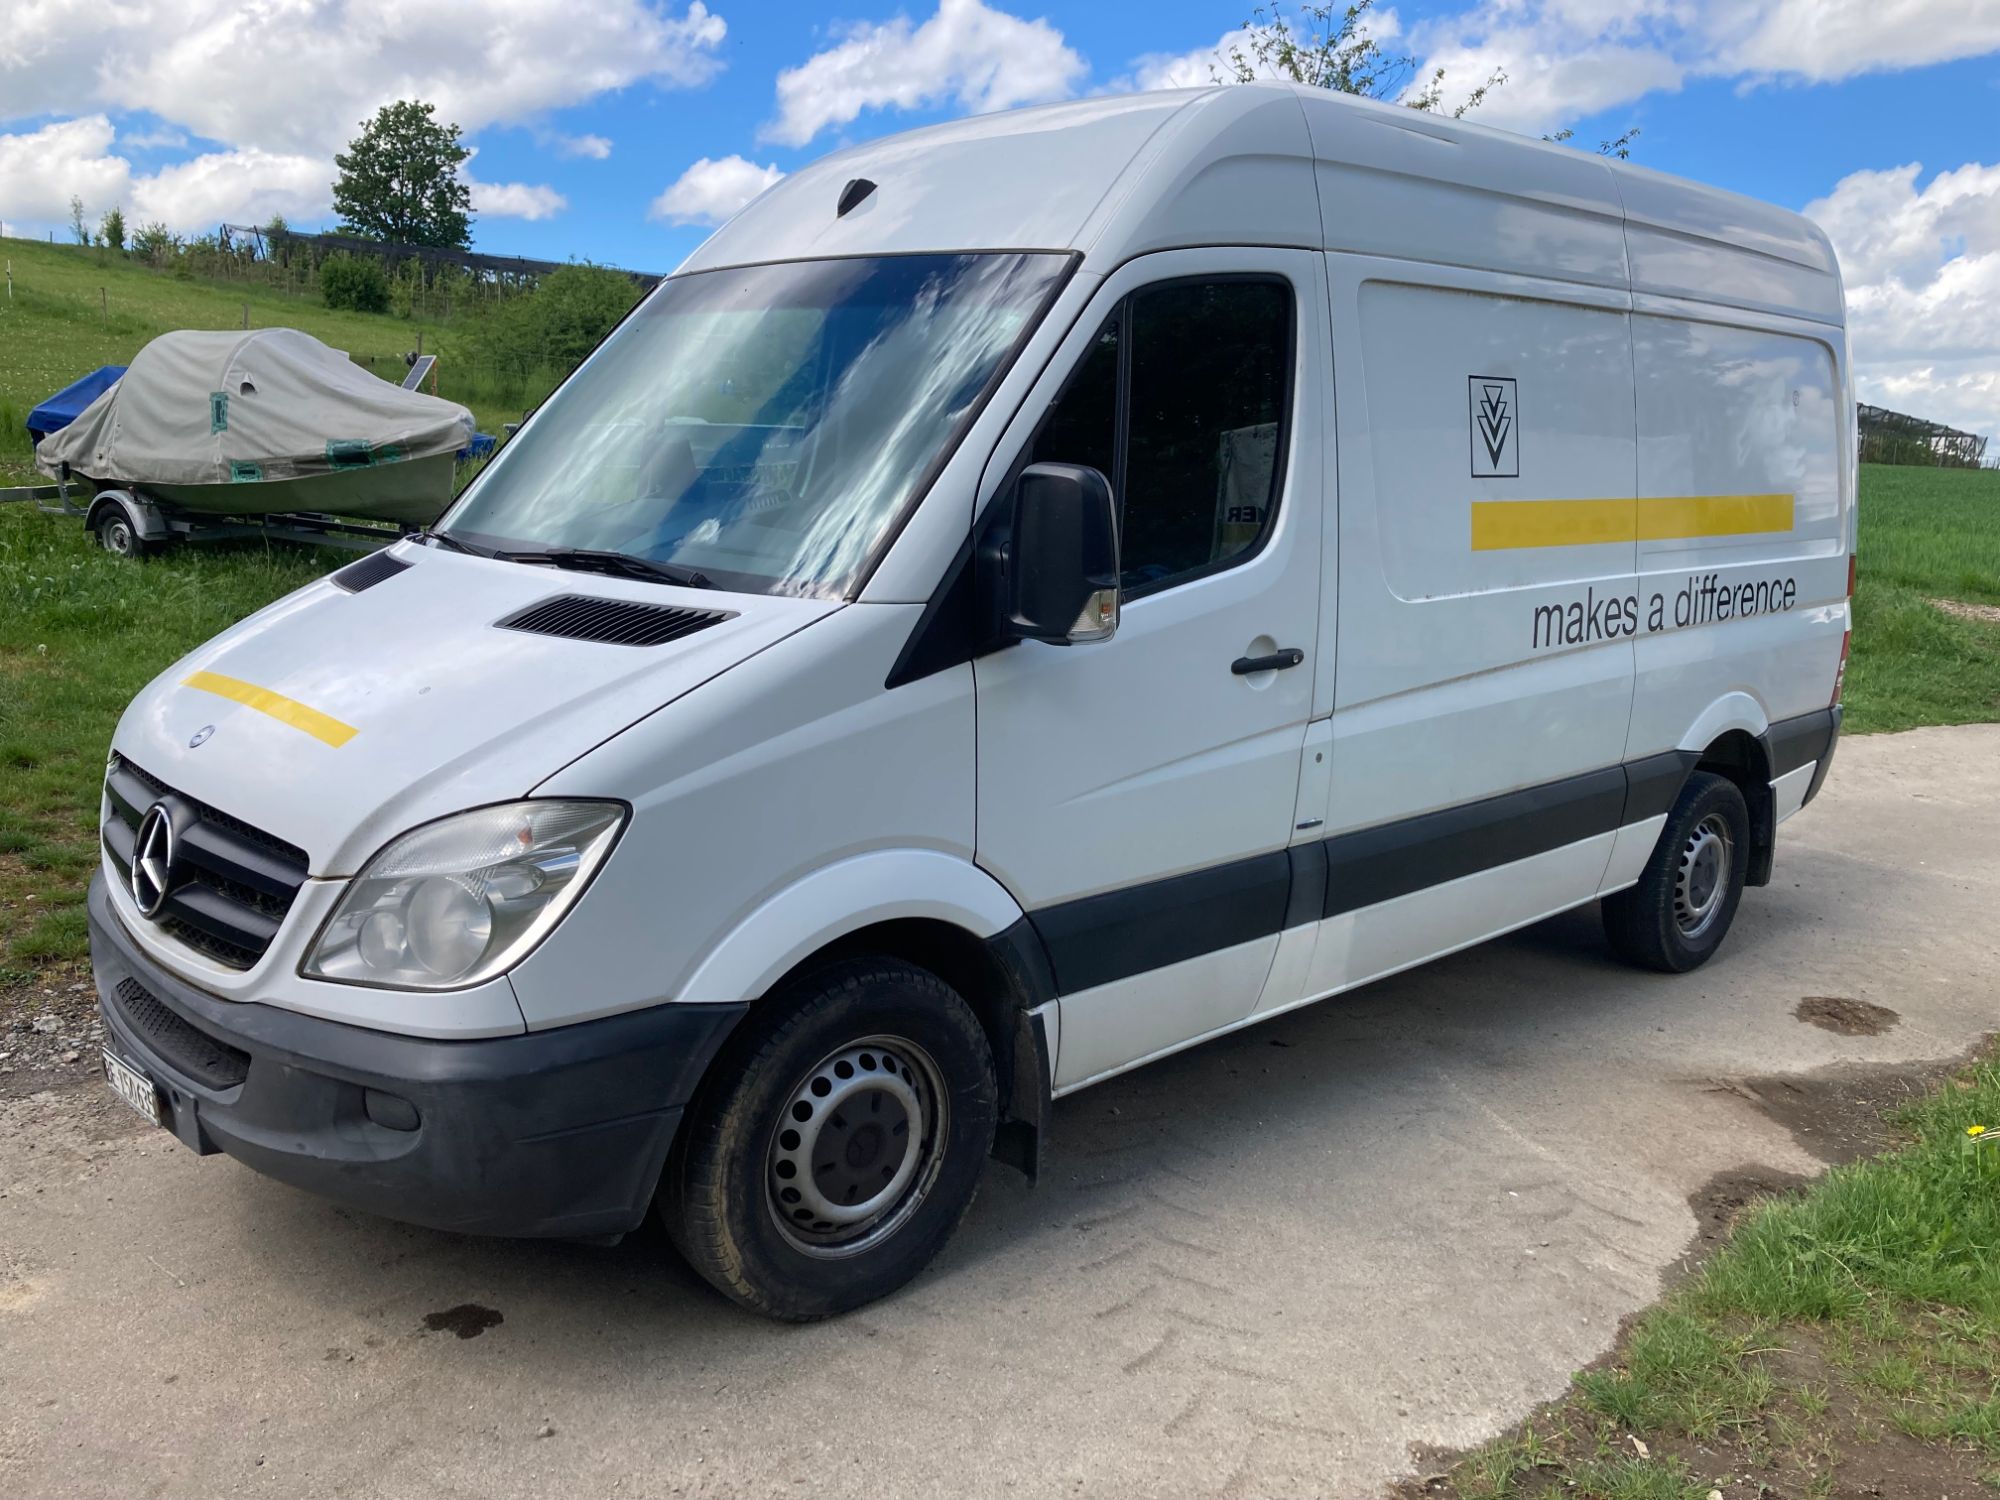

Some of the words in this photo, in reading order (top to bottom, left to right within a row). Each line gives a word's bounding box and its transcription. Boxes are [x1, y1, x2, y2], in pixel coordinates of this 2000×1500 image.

[1532, 586, 1638, 649] makes
[1647, 592, 1665, 632] a
[1674, 573, 1797, 628] difference
